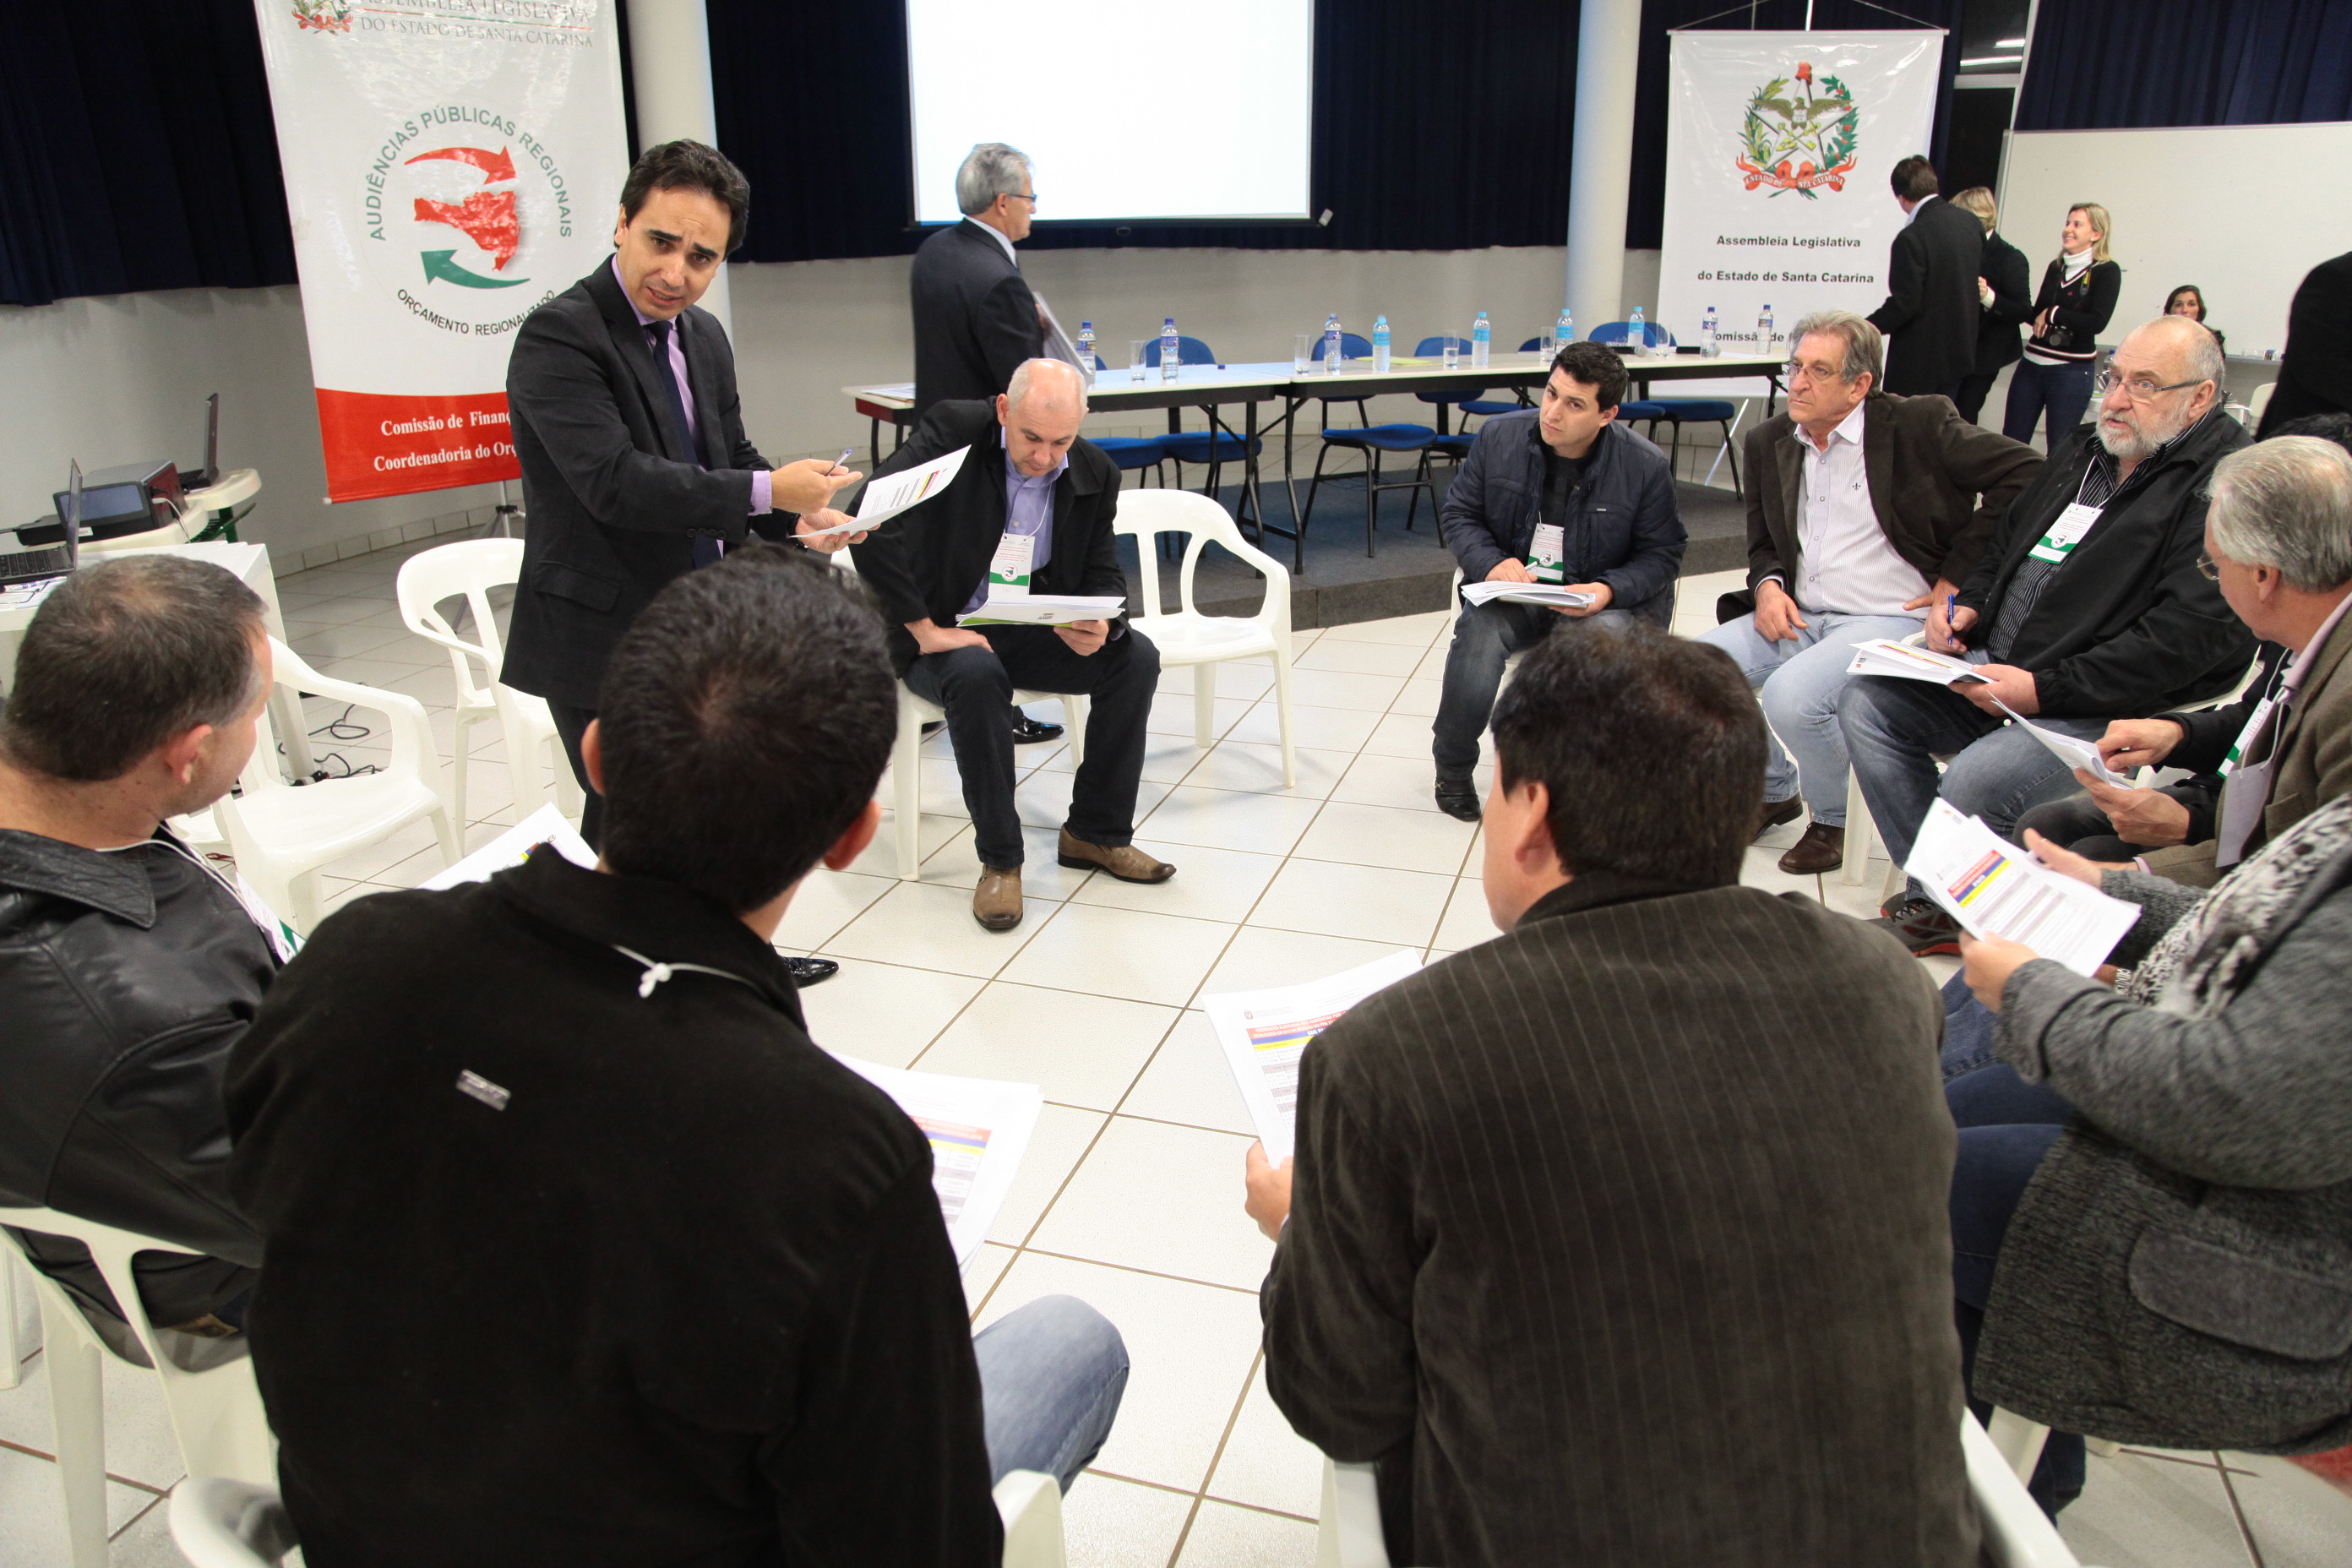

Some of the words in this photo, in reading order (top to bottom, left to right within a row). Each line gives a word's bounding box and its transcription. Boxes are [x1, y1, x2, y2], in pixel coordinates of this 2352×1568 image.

[362, 0, 476, 12] BLEIA
[362, 17, 385, 31] DO
[391, 19, 450, 36] ESTADO
[455, 24, 473, 39] DE
[479, 26, 522, 42] SANTA
[525, 30, 593, 47] CATARINA
[366, 121, 419, 241] AUDIÊNCIAS
[421, 105, 516, 137] PÚBLICAS
[519, 132, 572, 237] REGIONAIS
[1745, 175, 1772, 183] ESTADO
[1812, 175, 1843, 186] CATARINA
[1717, 235, 1788, 246] Assembleia
[1793, 237, 1861, 248] Legislativa
[1697, 270, 1712, 280] do
[1717, 271, 1758, 281] Estado
[1762, 271, 1778, 281] de
[1782, 272, 1816, 282] Santa
[1821, 272, 1874, 283] Catarina
[397, 289, 469, 334] ORÇAMENTO
[1714, 331, 1759, 342] omissã
[1771, 332, 1784, 342] de
[381, 416, 444, 436] Comissão
[447, 414, 463, 429] de
[374, 446, 472, 471] Coordenadoria
[475, 444, 491, 459] do
